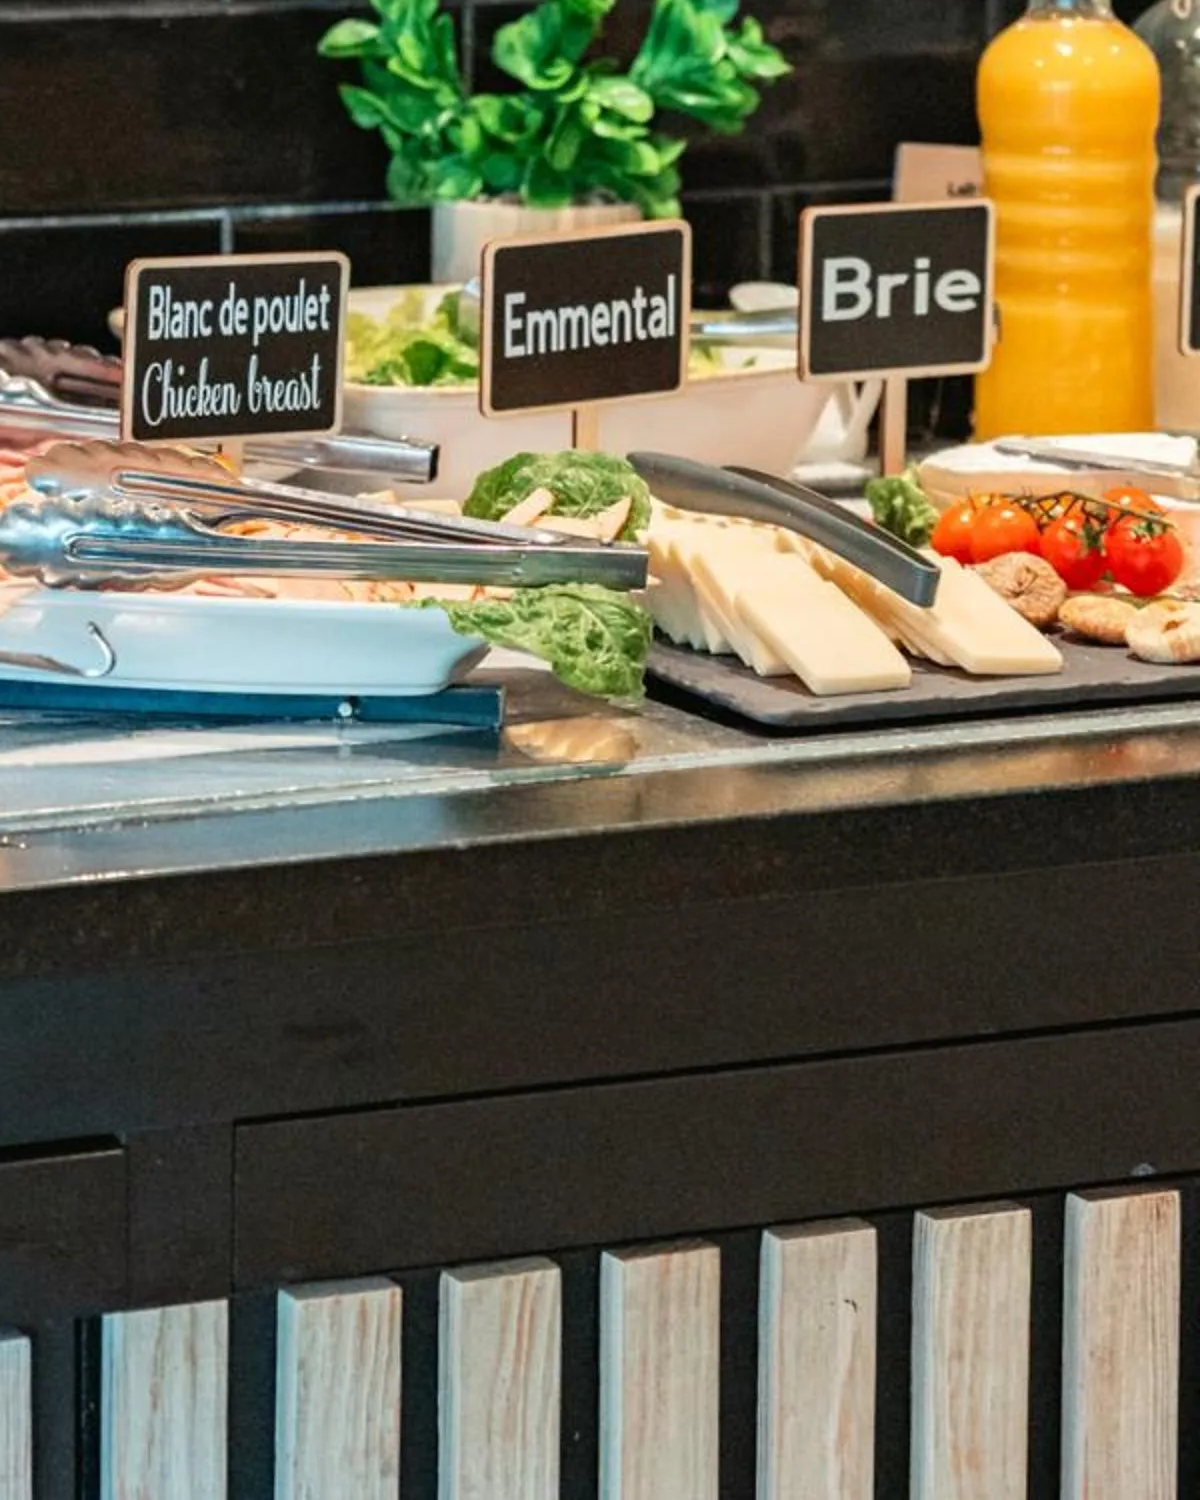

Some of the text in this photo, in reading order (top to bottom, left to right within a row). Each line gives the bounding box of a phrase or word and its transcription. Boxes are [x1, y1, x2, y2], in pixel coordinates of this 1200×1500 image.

[148, 277, 331, 347] Blanc de poulet
[504, 273, 676, 358] Emmental
[822, 257, 981, 322] Brie
[142, 353, 321, 426] Chicken breast
